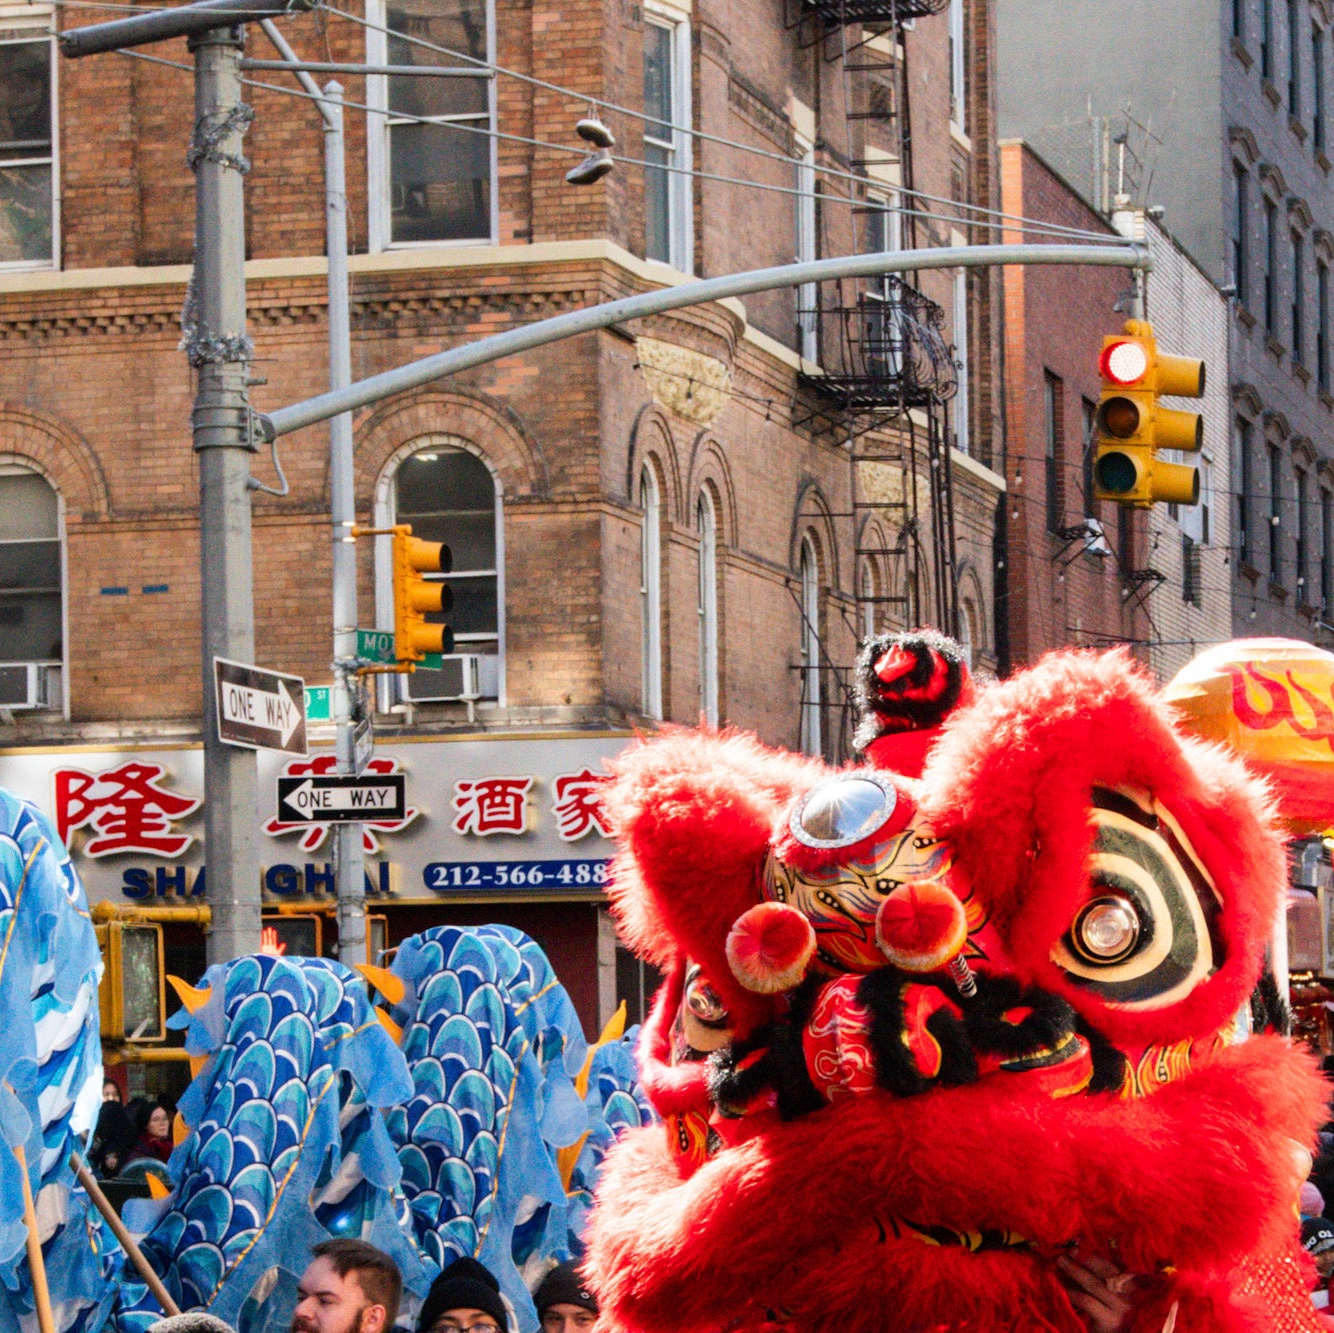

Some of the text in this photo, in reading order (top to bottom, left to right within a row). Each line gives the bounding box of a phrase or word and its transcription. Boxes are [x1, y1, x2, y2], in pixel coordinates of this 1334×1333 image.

[229, 688, 255, 721] ONE
[266, 696, 292, 729] WAY
[297, 788, 389, 808] ONE WAY
[433, 863, 608, 886] 212-566-488
